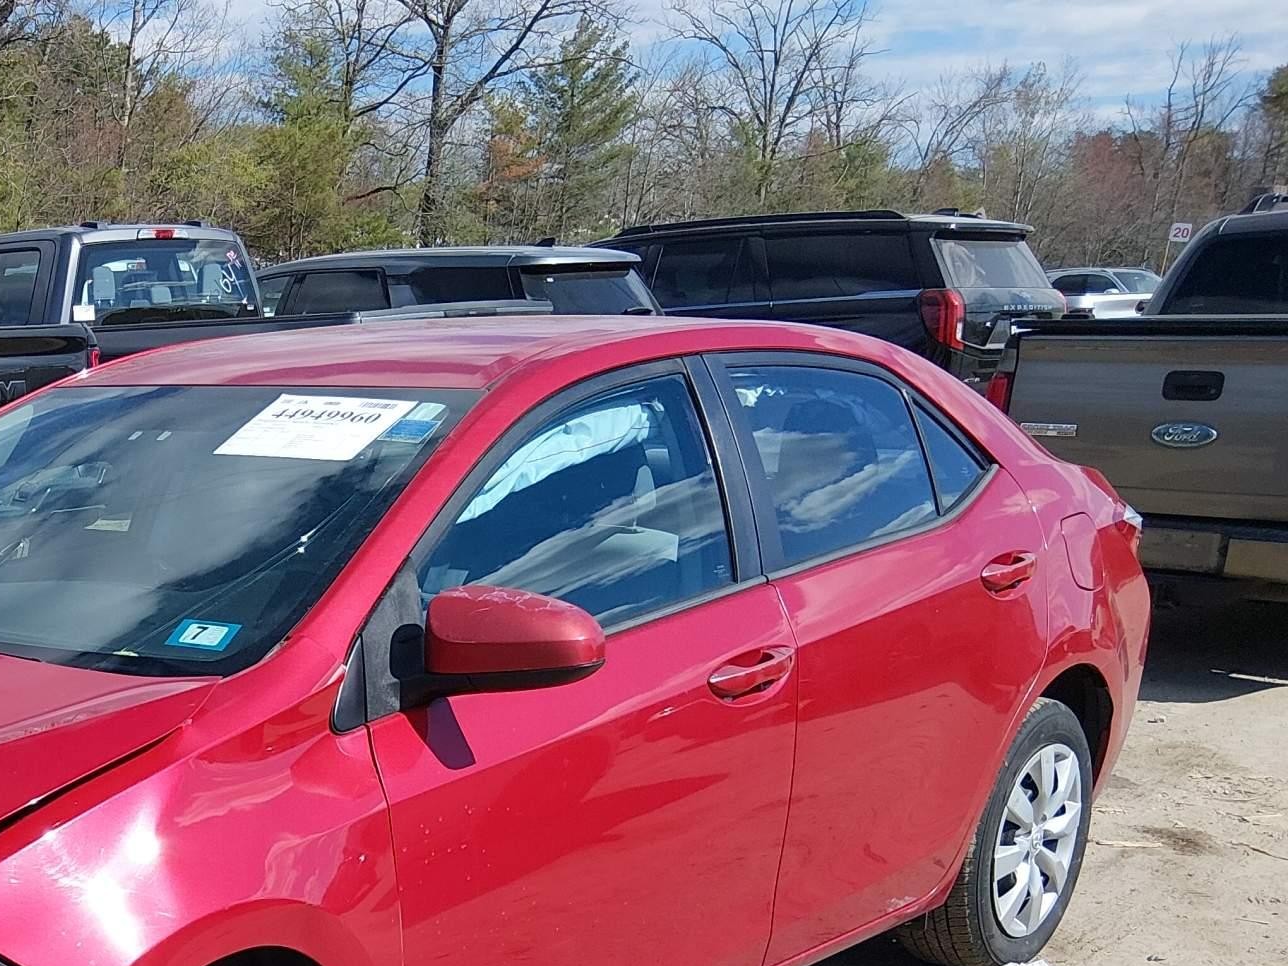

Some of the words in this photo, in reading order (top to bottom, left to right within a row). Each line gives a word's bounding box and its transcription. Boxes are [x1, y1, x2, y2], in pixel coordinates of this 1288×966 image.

[1173, 227, 1189, 238] 20
[272, 408, 381, 424] 44949960
[190, 626, 209, 641] 7
